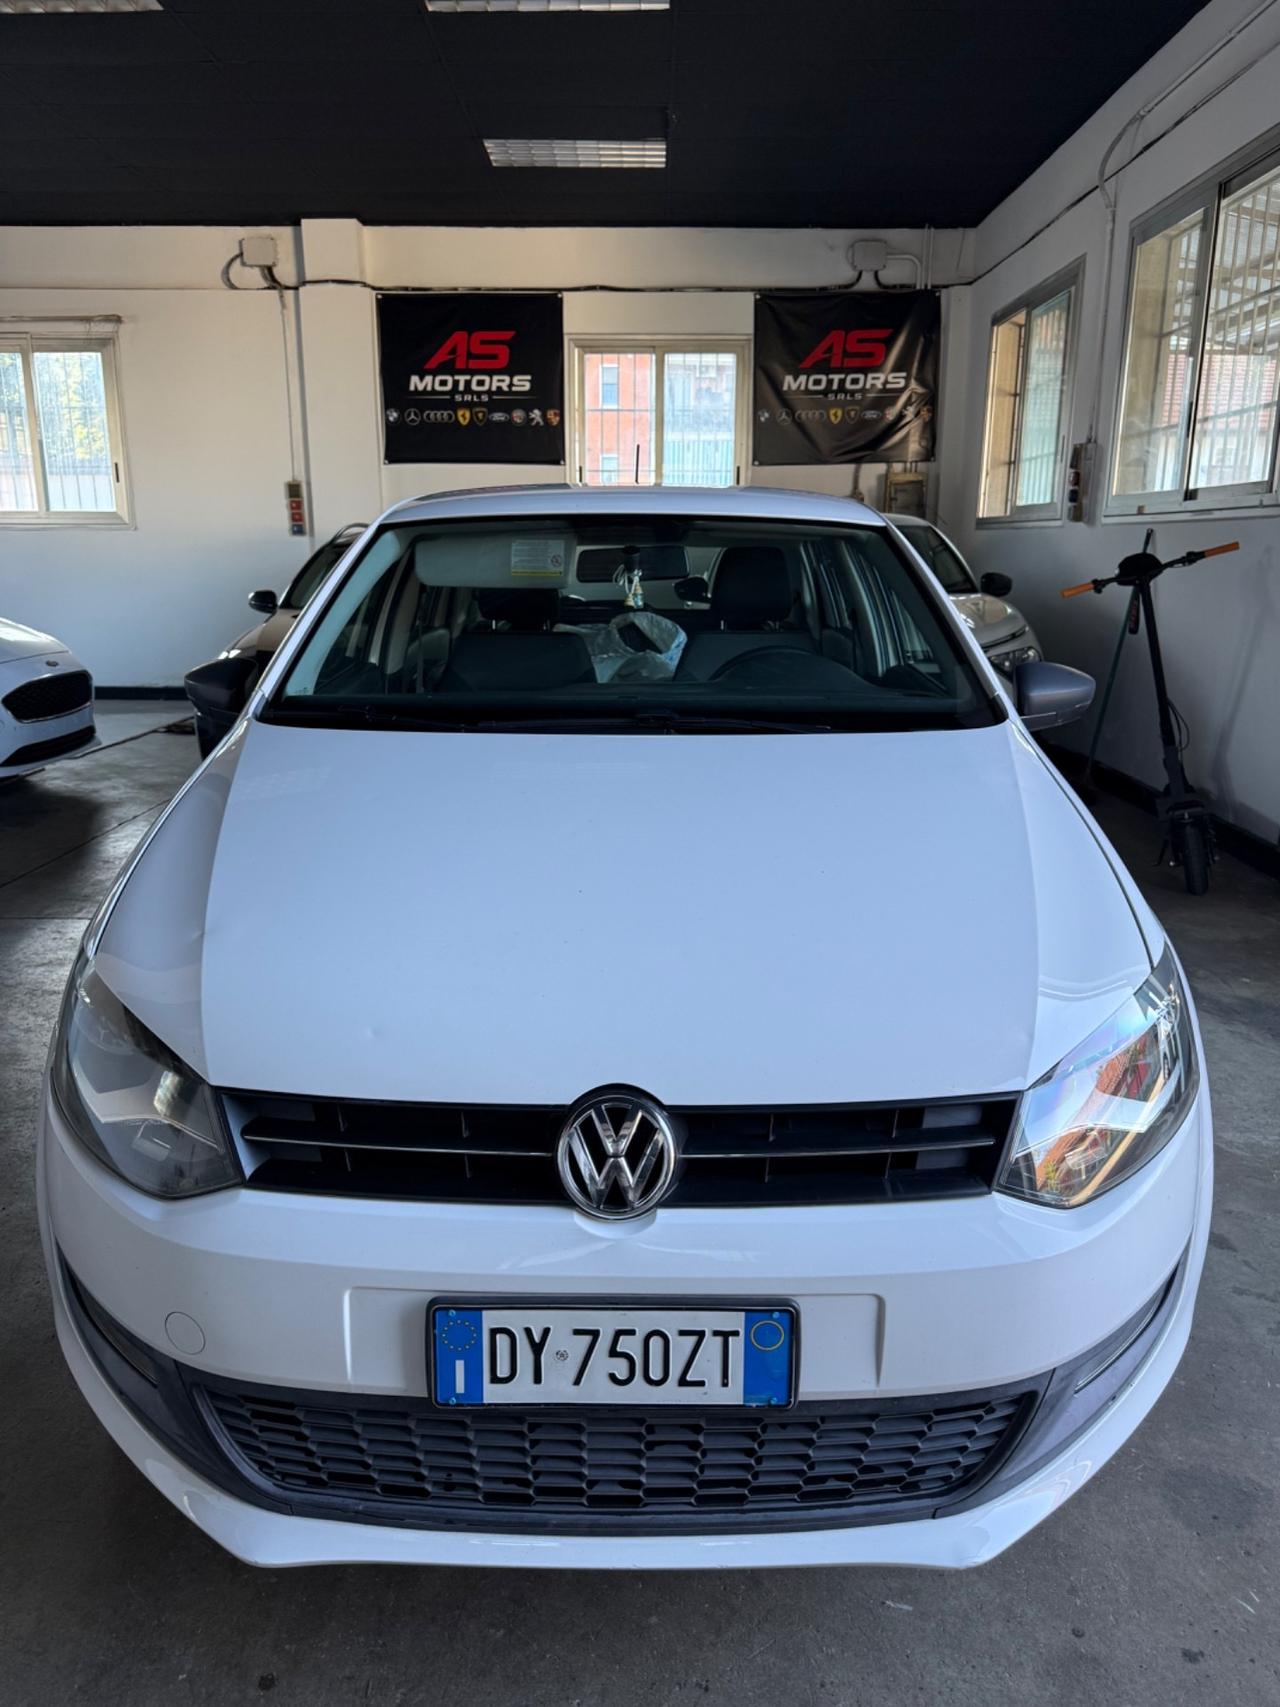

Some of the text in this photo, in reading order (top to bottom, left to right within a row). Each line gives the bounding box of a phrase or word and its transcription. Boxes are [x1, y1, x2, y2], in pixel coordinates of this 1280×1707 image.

[424, 331, 516, 369] AS
[799, 329, 893, 369] AS
[409, 375, 532, 392] MOTORS
[783, 372, 907, 391] MOTORS
[454, 394, 489, 402] SRLS
[827, 392, 863, 401] SRLS
[489, 1327, 551, 1385] DY
